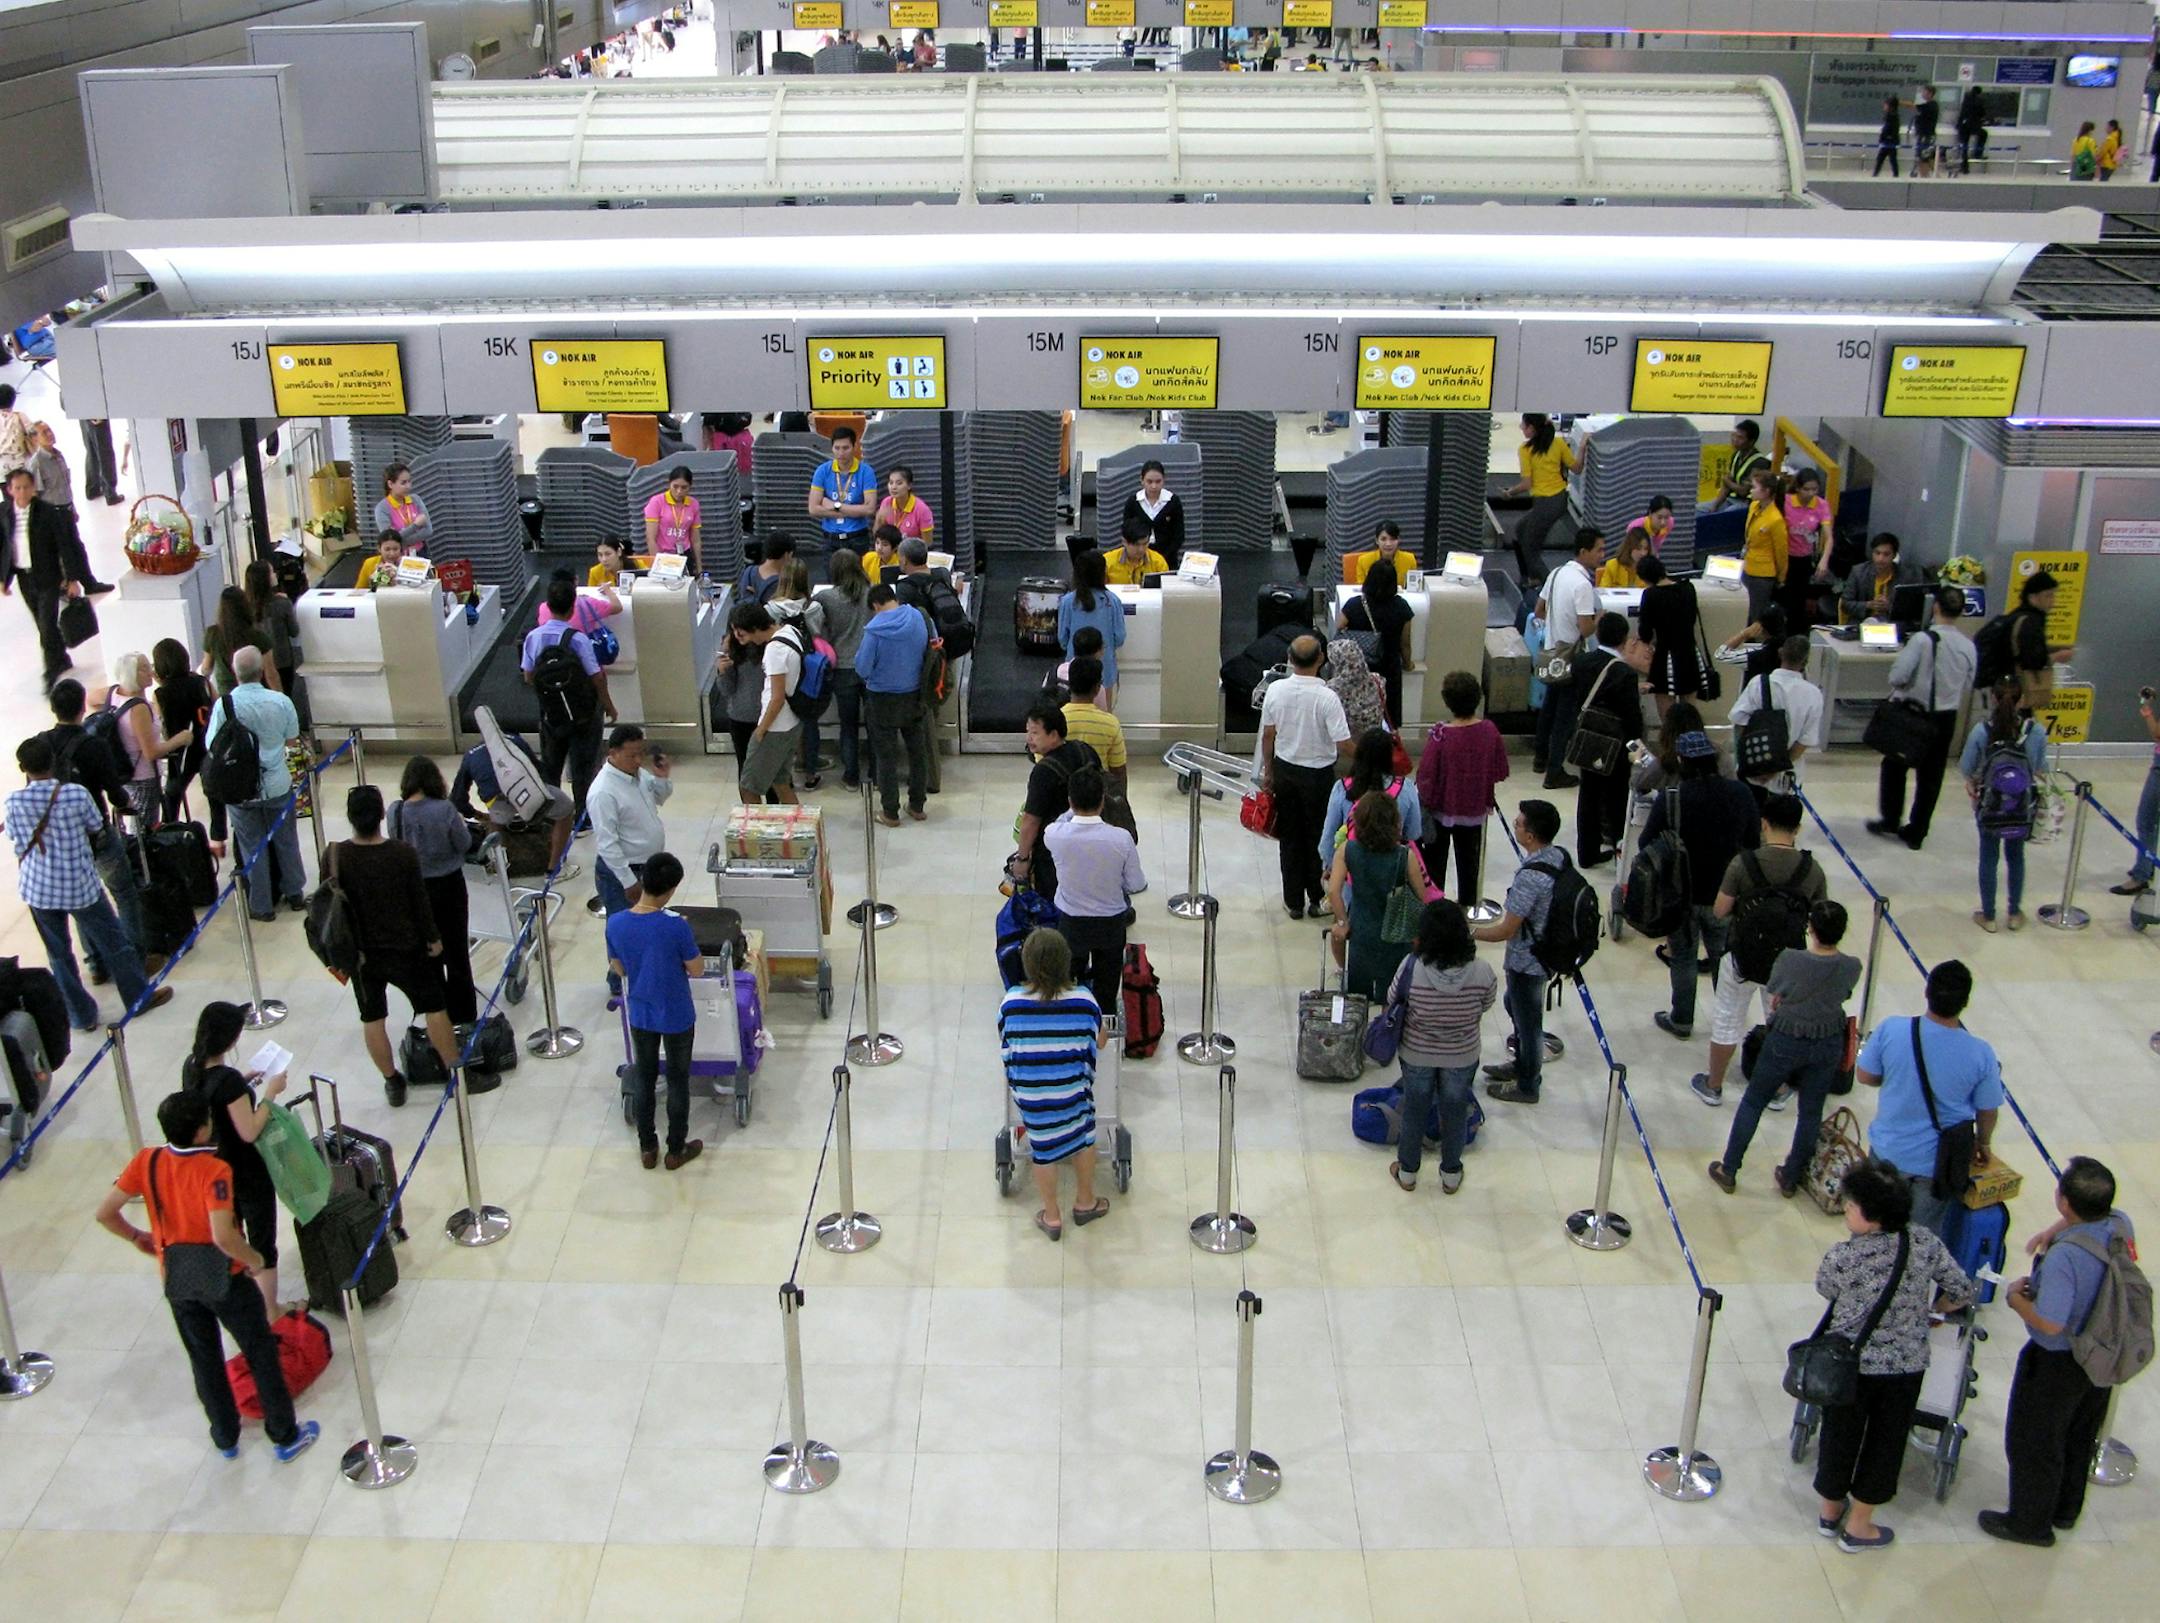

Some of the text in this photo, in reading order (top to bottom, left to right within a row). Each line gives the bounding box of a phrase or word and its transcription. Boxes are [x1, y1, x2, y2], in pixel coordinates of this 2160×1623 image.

[231, 342, 260, 360] 15J
[484, 337, 518, 357] 15K
[762, 334, 794, 353] 15L
[1027, 333, 1064, 351] 15M
[1304, 333, 1338, 352] 15N
[1585, 336, 1618, 355] 15P
[1836, 340, 1872, 359] 15Q
[297, 357, 333, 367] NOK AIR
[561, 354, 597, 362] NOK AIR
[838, 351, 874, 359] NOK AIR
[1106, 351, 1143, 359] NOK AIR
[1383, 350, 1420, 359] NOK AIR
[1664, 354, 1702, 362] NOK AIR
[1919, 359, 1955, 368] NOK AIR
[821, 369, 881, 387] Priority
[2039, 562, 2080, 572] NOK AIR
[2046, 715, 2080, 738] 7 kgs.
